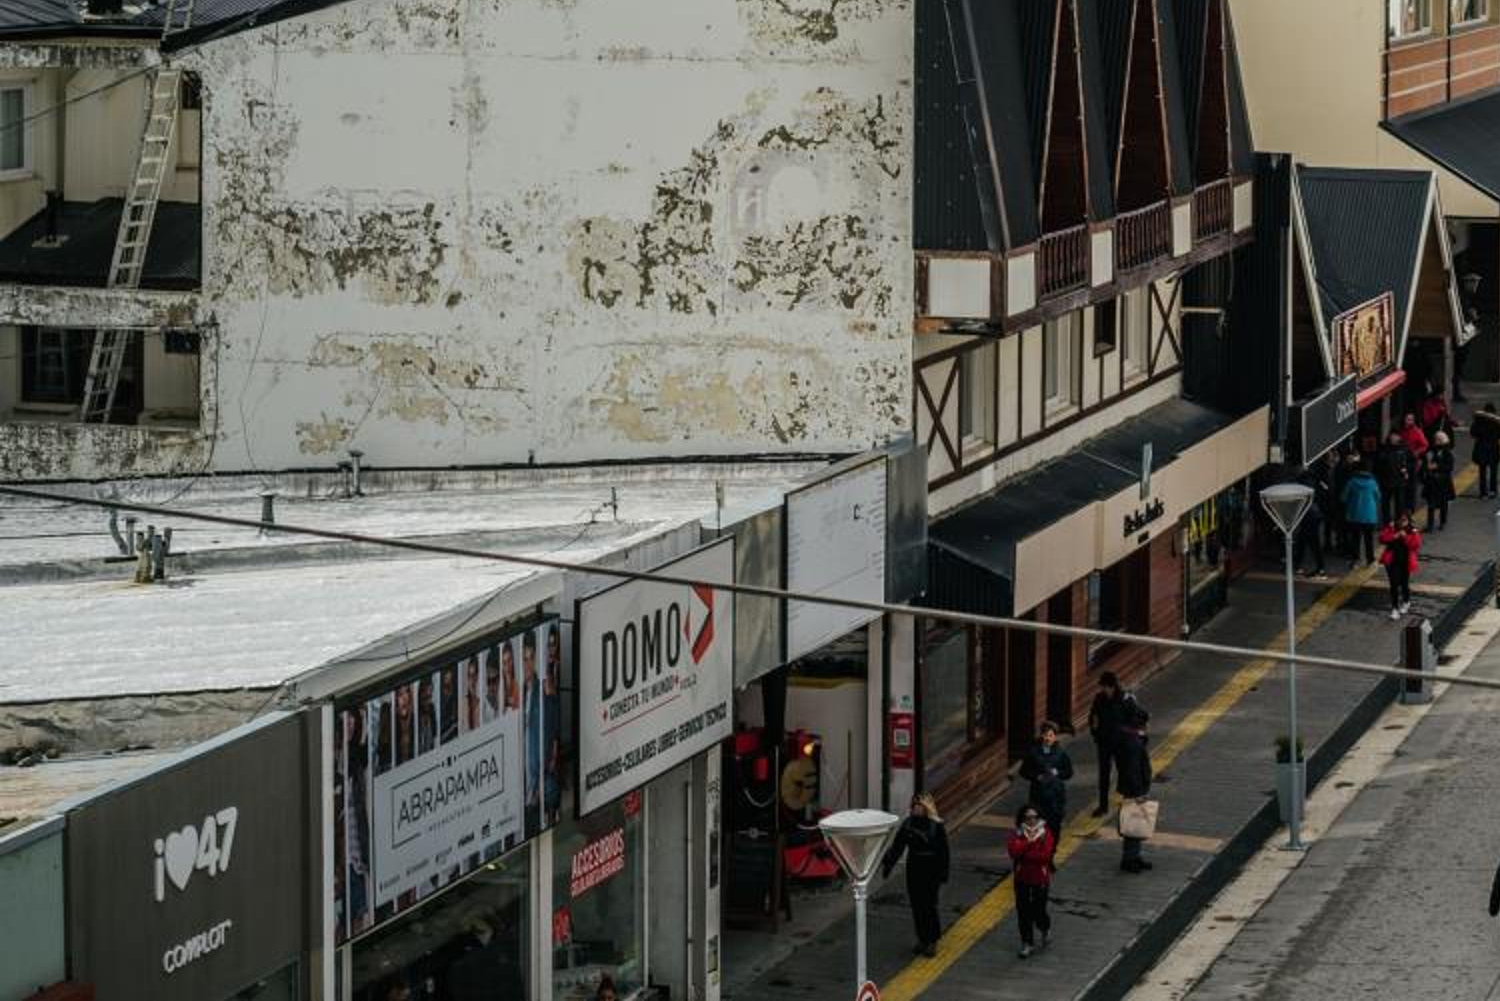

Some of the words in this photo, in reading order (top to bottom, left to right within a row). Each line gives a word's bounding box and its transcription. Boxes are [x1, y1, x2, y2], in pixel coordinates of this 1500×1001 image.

[602, 602, 681, 701] DOMO
[397, 755, 500, 830] ABRAPAMPA
[163, 920, 230, 973] COMPLOT
